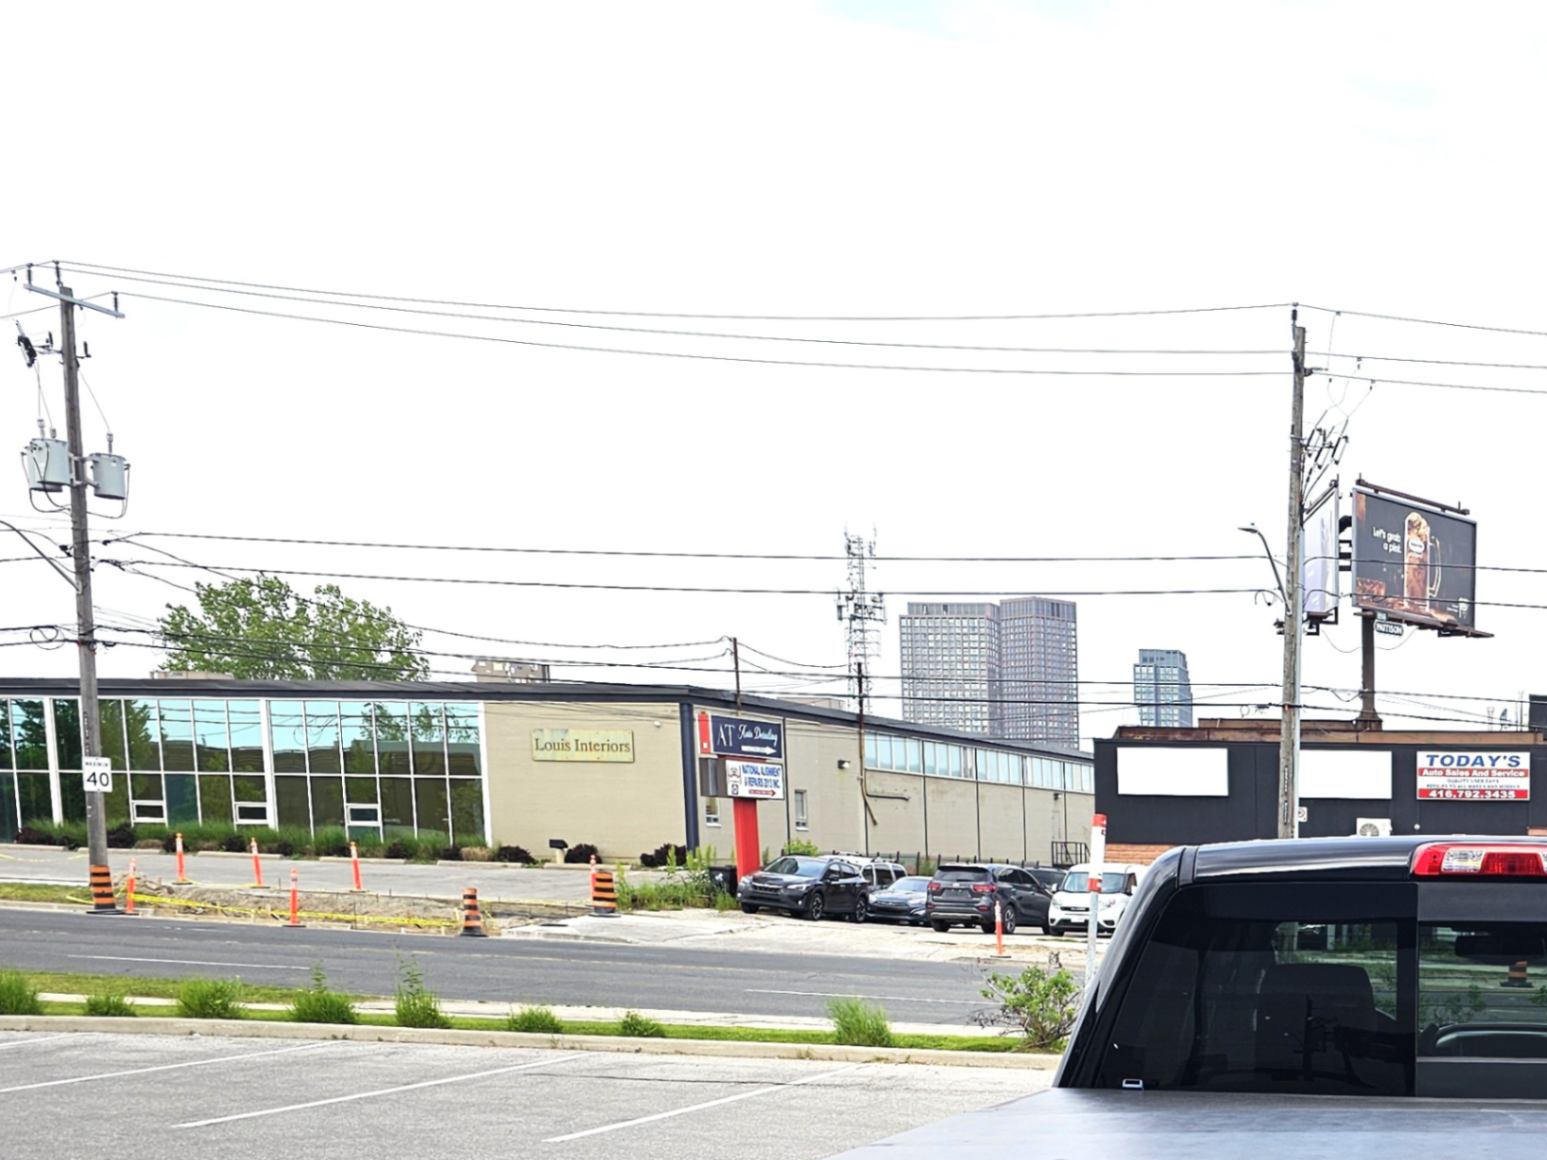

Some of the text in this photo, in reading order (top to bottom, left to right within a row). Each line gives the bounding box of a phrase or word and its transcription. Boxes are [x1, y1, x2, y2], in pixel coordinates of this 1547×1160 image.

[1373, 526, 1386, 539] Let's
[1376, 622, 1402, 635] PATTISON
[717, 724, 735, 747] AT
[535, 738, 631, 752] Louis Interiors
[1426, 755, 1521, 768] TODAY'S
[87, 772, 109, 787] 40
[1422, 769, 1525, 778] Auto Sales And Service
